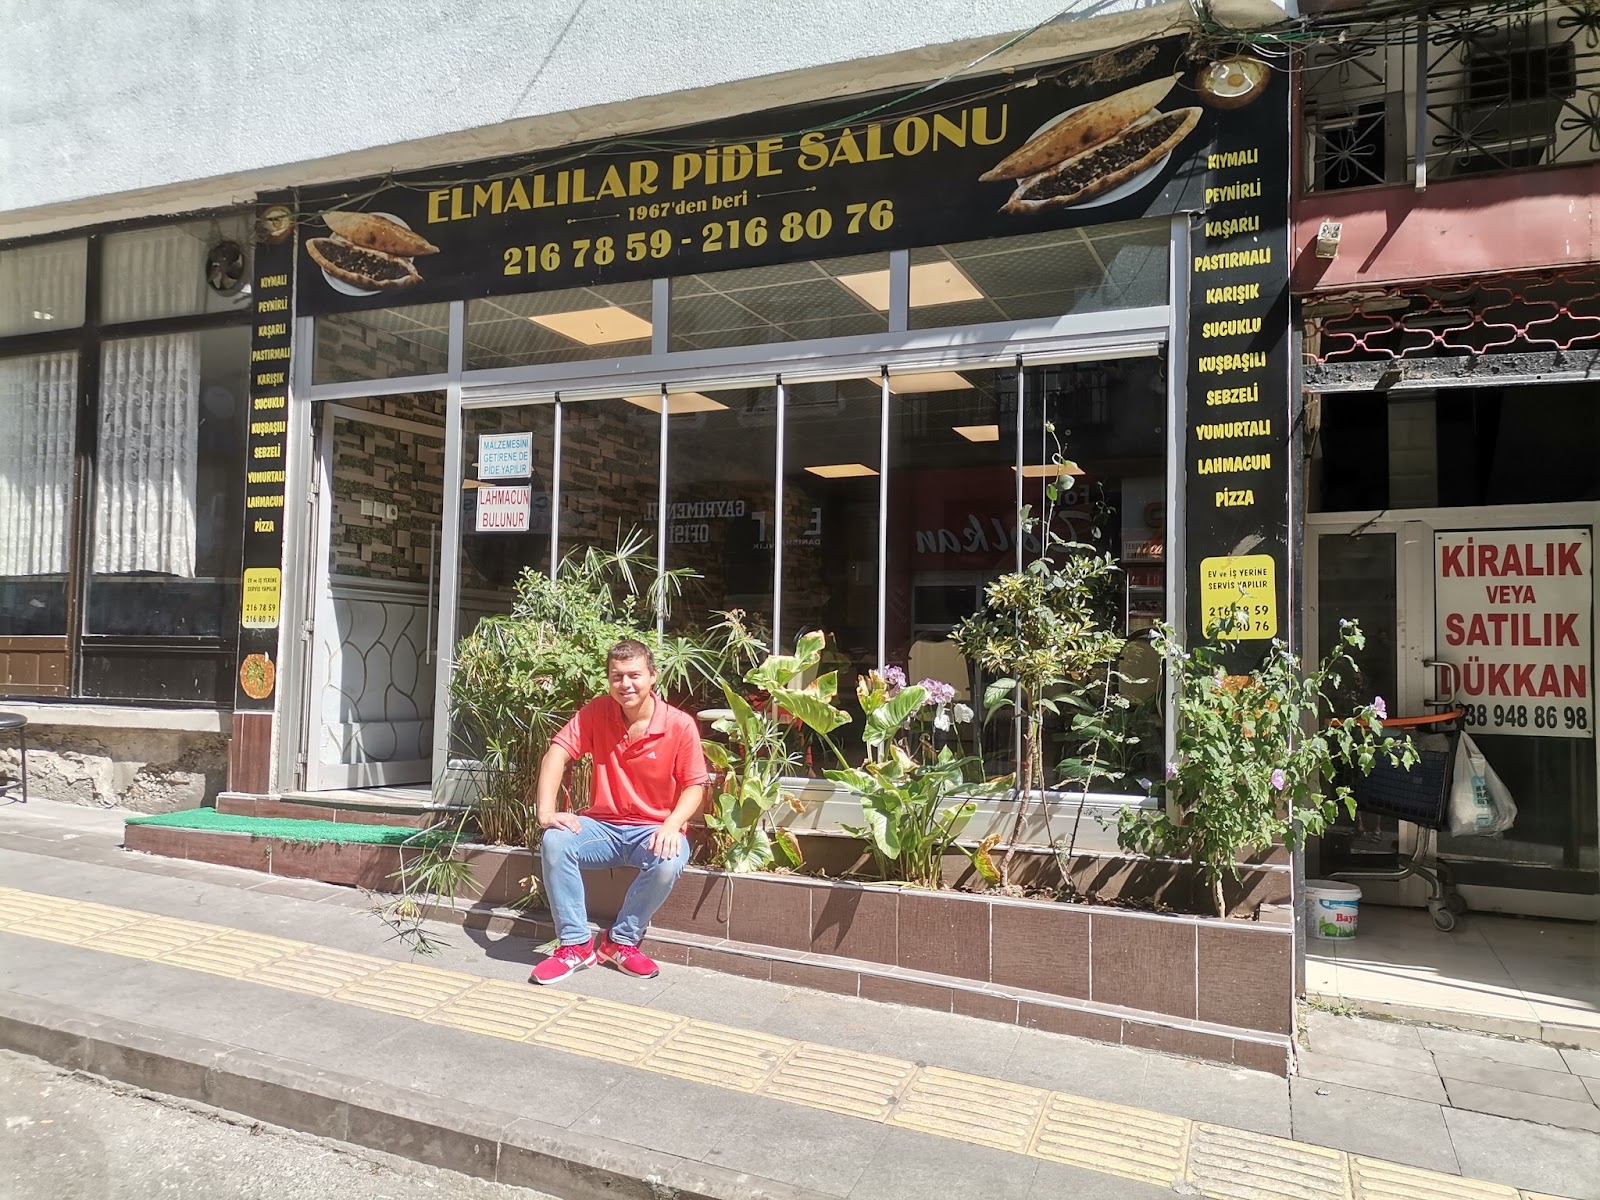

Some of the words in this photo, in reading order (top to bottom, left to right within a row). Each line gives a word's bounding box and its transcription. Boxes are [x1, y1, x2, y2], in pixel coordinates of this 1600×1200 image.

[426, 160, 659, 225] ELMALILAR
[672, 137, 783, 192] PİDE
[797, 103, 1009, 172] SALONU
[1207, 148, 1259, 170] KIYMALI
[1205, 178, 1261, 204] PEYNİRLİ
[627, 196, 708, 221] 1967'den
[712, 190, 748, 210] beri
[1205, 215, 1259, 239] KAŞARLI
[503, 242, 561, 276] 216
[571, 236, 616, 268] 78
[625, 229, 673, 262] 59
[702, 216, 767, 252] 216
[780, 208, 833, 244] 80
[845, 199, 895, 234] 76
[1194, 247, 1271, 272] PASTIRMALI
[260, 274, 288, 289] KIYMALI
[1206, 283, 1260, 305] KARIŞIK
[258, 295, 289, 313] PEYNİRLİ
[258, 323, 286, 339] KAŞARLI
[1202, 317, 1262, 339] SUCUKLU
[252, 347, 290, 362] PASTIRMALI
[1198, 352, 1266, 375] KUŞBAŞILI
[257, 372, 285, 387] KARIŞIK
[1206, 382, 1259, 406] SEBZELİ
[253, 396, 285, 410] SUCUKLU
[251, 420, 286, 437] KUŞBAŞILI
[1195, 419, 1271, 441] YUMURTALI
[253, 443, 281, 459] SEBZELİ
[519, 451, 528, 461] DE
[484, 464, 499, 474] PİDE
[501, 464, 526, 474] YAPILIR
[1197, 453, 1271, 475] LAHMACUN
[247, 470, 285, 484] YUMURTALI
[247, 494, 284, 508] LAHMACUN
[480, 489, 529, 505] LAHMACUN
[1215, 487, 1255, 507] PİZZA
[254, 518, 275, 532] PİZZA
[482, 512, 525, 527] BULUNUR
[1442, 537, 1583, 578] KİRALIK
[1207, 570, 1217, 578] EV
[1229, 568, 1237, 579] İŞ
[1239, 567, 1268, 577] YERİNE
[1208, 580, 1235, 589] SERVİS
[1237, 580, 1268, 588] YAPILIR
[1485, 585, 1536, 604] VEYA
[268, 603, 276, 611] 59
[1255, 605, 1269, 616] 59
[245, 615, 257, 623] 216
[258, 615, 266, 623] 80
[268, 615, 276, 623] 76
[1255, 621, 1269, 631] 76
[1445, 613, 1580, 647] SATILIK
[1440, 656, 1587, 698] DÜKKAN
[1493, 704, 1528, 728] 948
[1534, 705, 1558, 729] 86
[1563, 706, 1588, 729] 98
